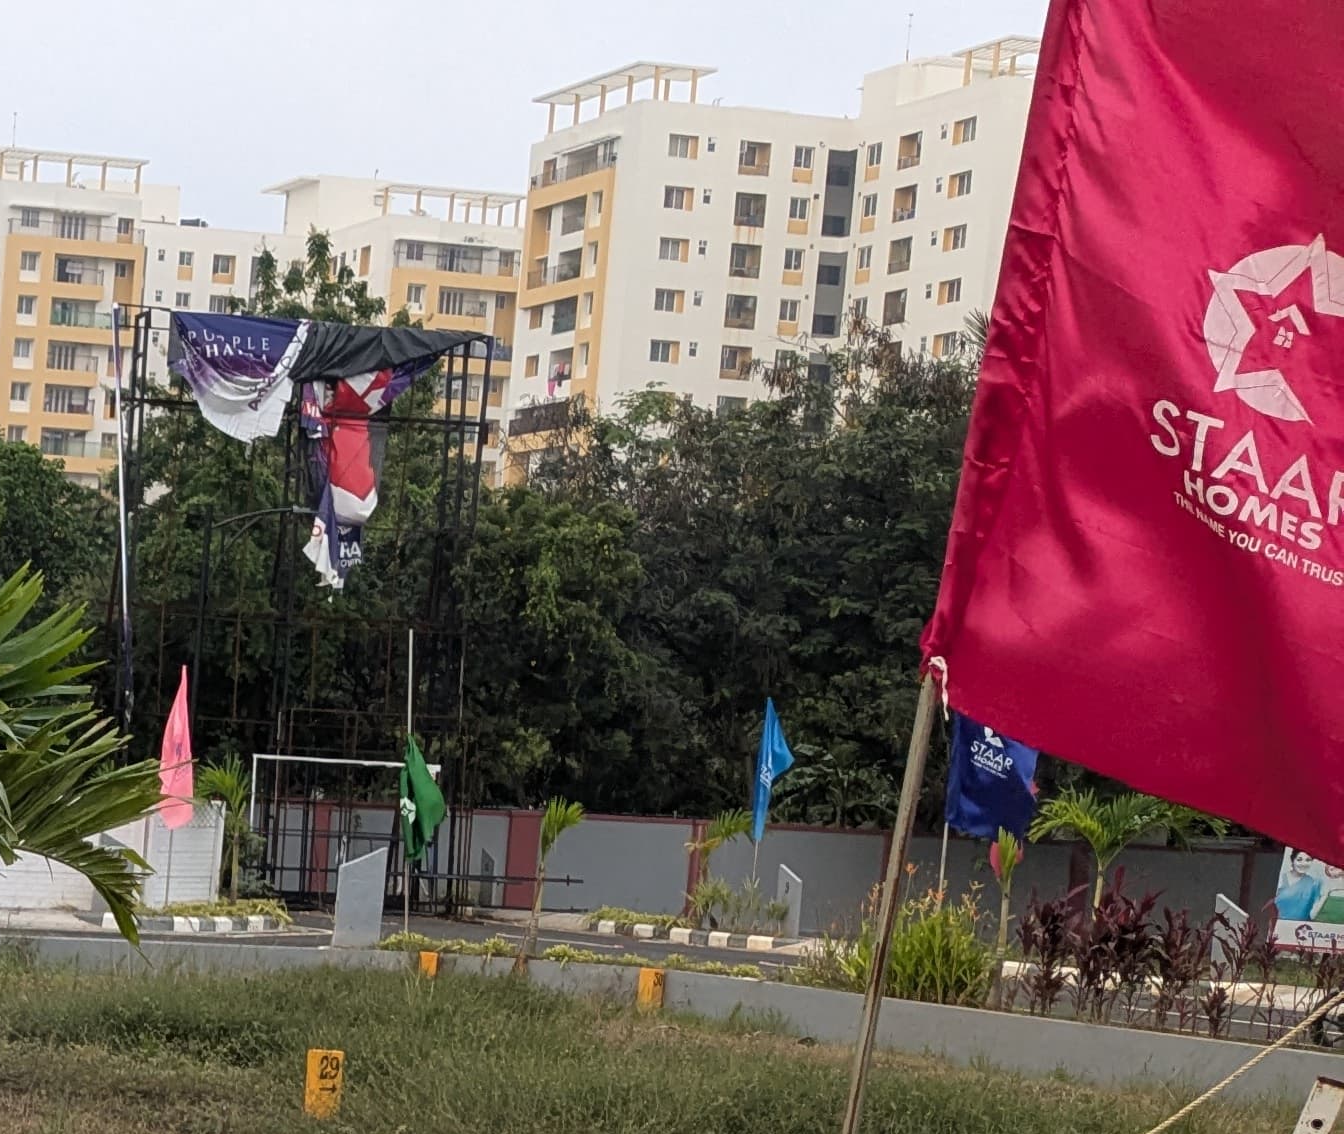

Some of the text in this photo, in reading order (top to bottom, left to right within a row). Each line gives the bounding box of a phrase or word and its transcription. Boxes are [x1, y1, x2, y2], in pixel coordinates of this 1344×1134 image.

[1184, 470, 1323, 550] HOMES
[1196, 510, 1226, 538] NAME
[1228, 529, 1261, 552] YOU
[1265, 543, 1298, 569] CAN
[1302, 558, 1344, 586] TRUS
[971, 740, 1013, 770] STAAR
[320, 1055, 339, 1079] 29
